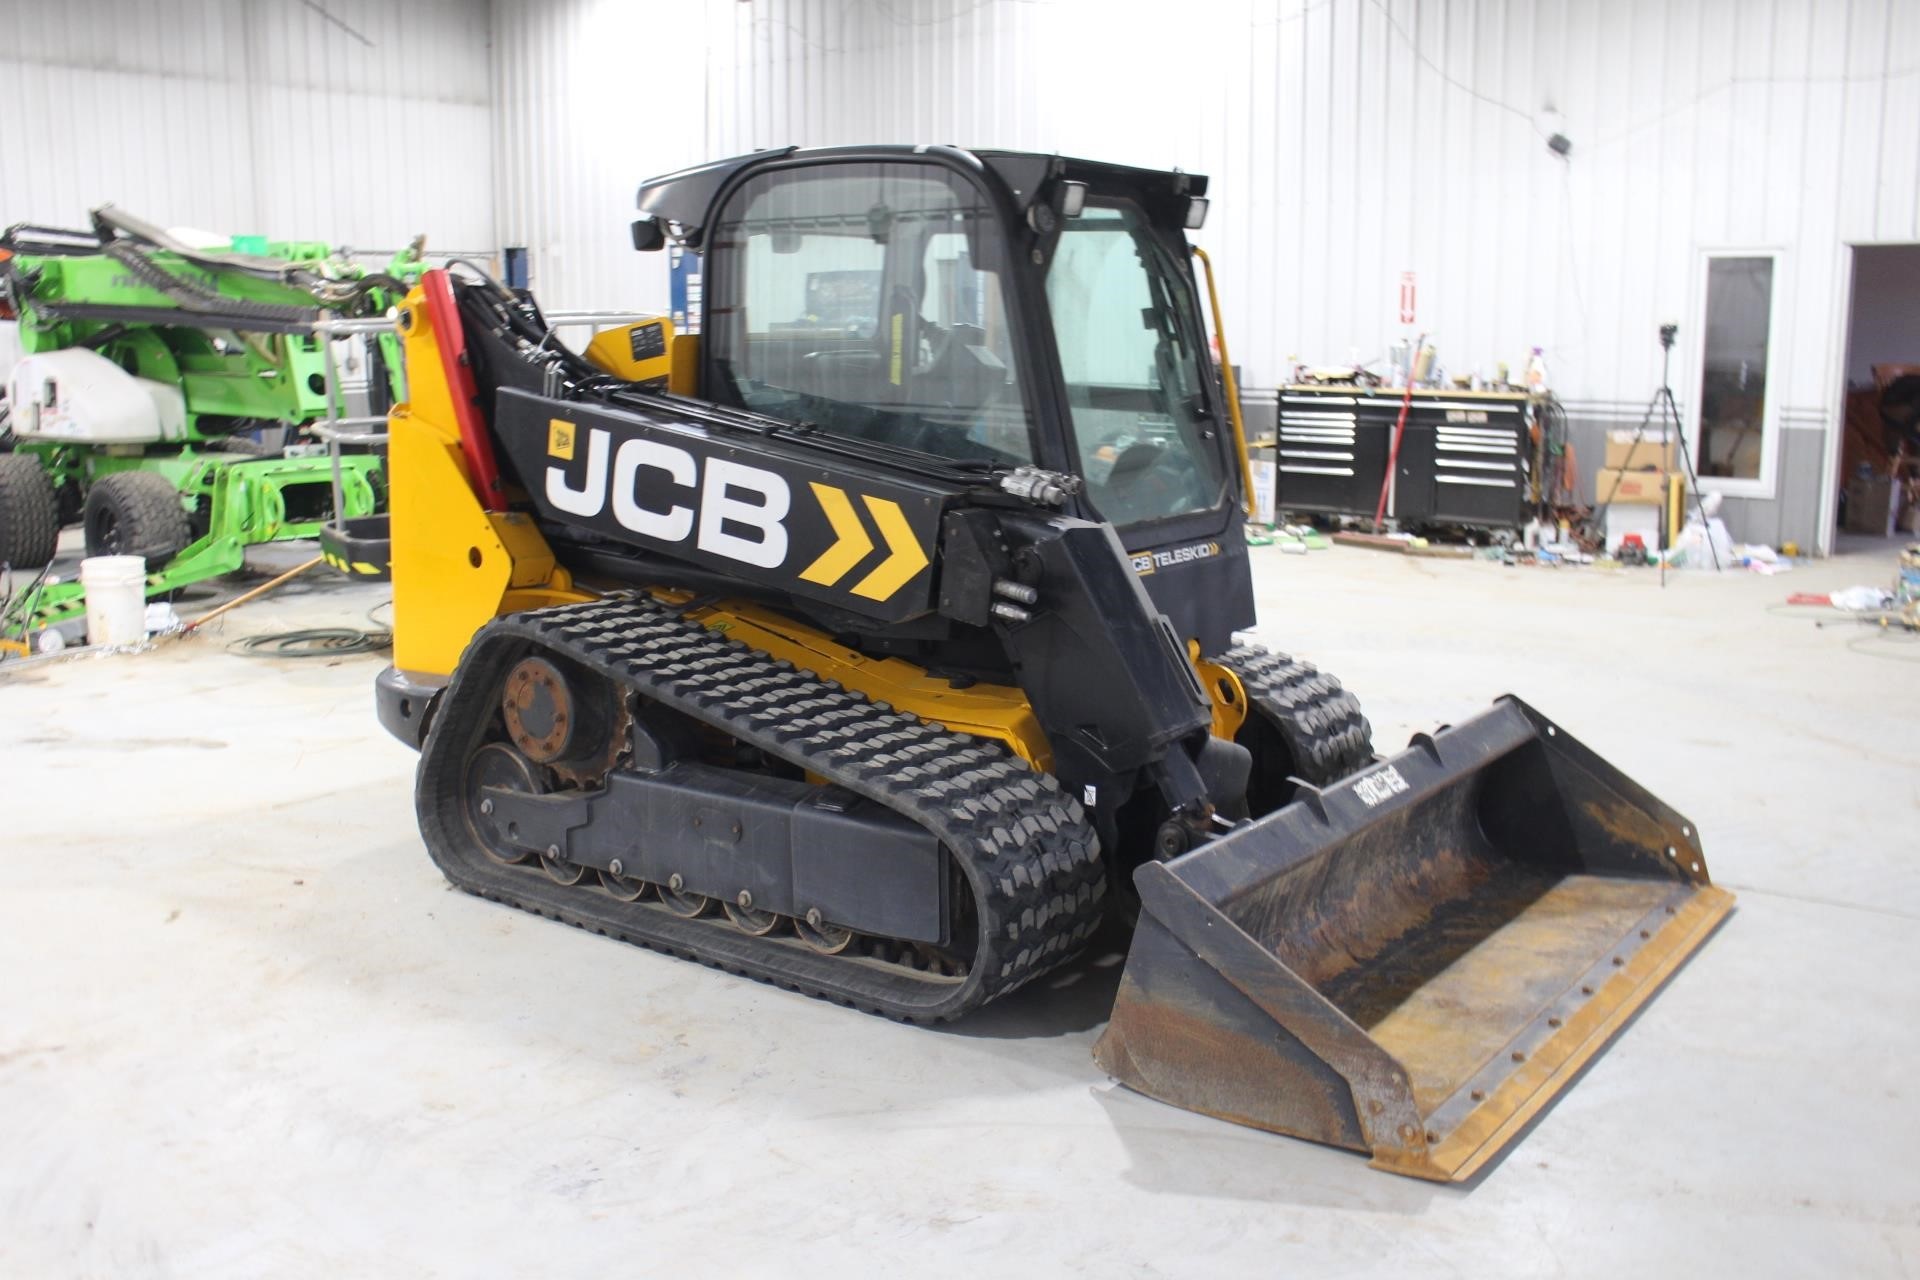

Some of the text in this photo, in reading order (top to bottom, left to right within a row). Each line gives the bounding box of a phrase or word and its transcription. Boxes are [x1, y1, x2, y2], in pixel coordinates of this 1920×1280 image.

[546, 428, 791, 569] JCB
[1132, 543, 1210, 571] CB TELESKID
